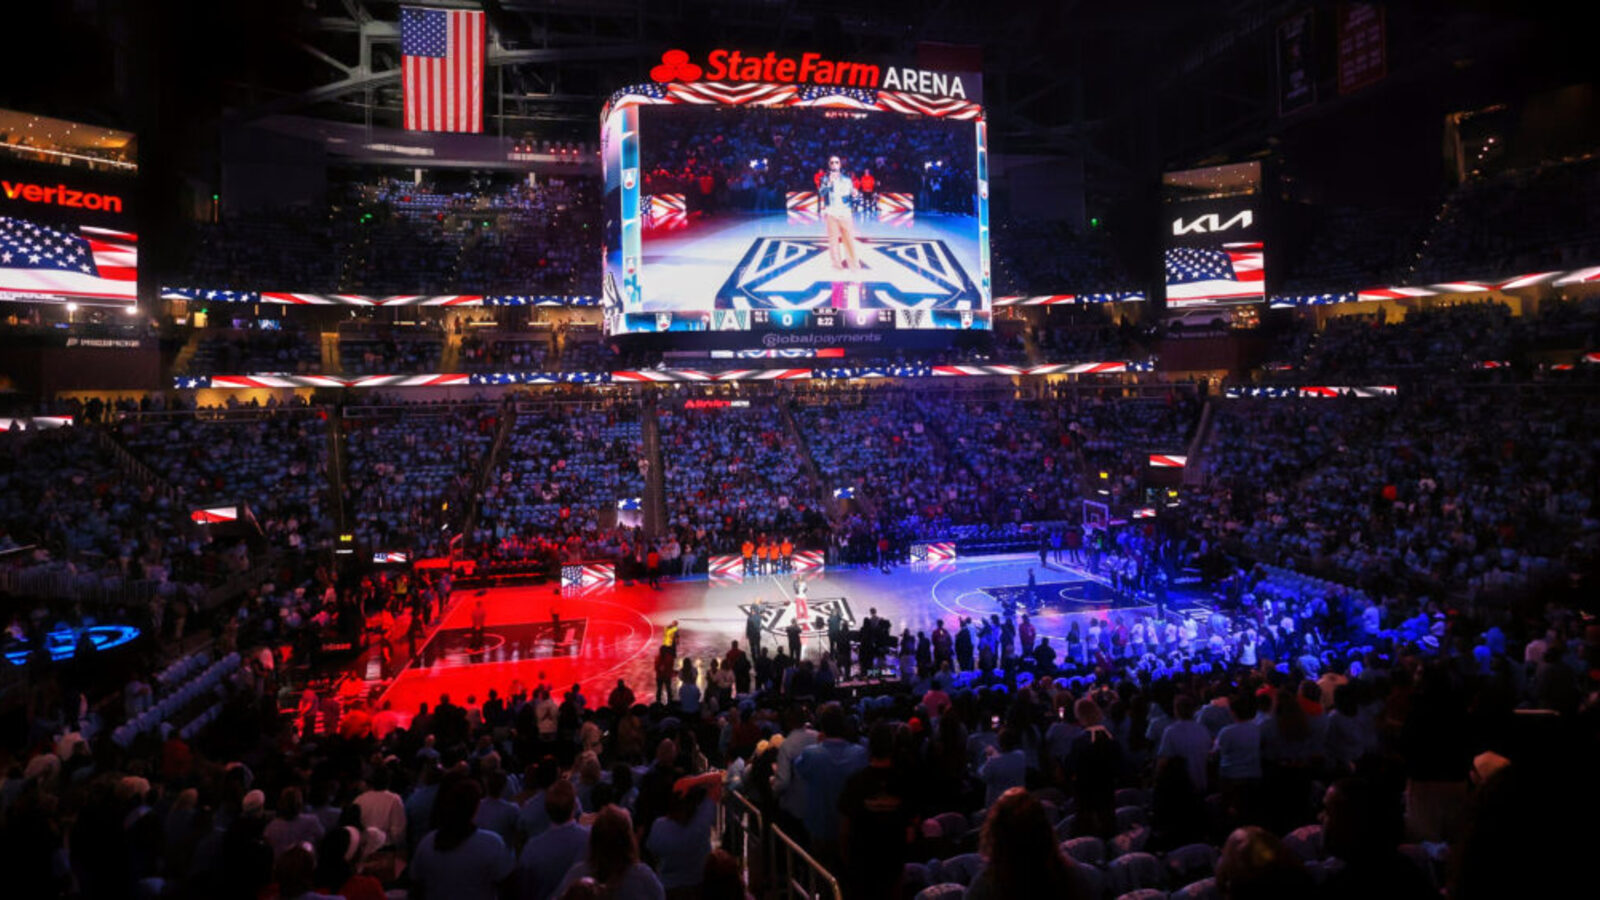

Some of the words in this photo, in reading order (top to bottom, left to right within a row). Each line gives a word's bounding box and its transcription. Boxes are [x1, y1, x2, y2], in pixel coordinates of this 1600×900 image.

[883, 66, 966, 99] ARENA
[1, 181, 123, 213] verizon
[1173, 210, 1252, 236] KIA
[782, 313, 793, 327] 0
